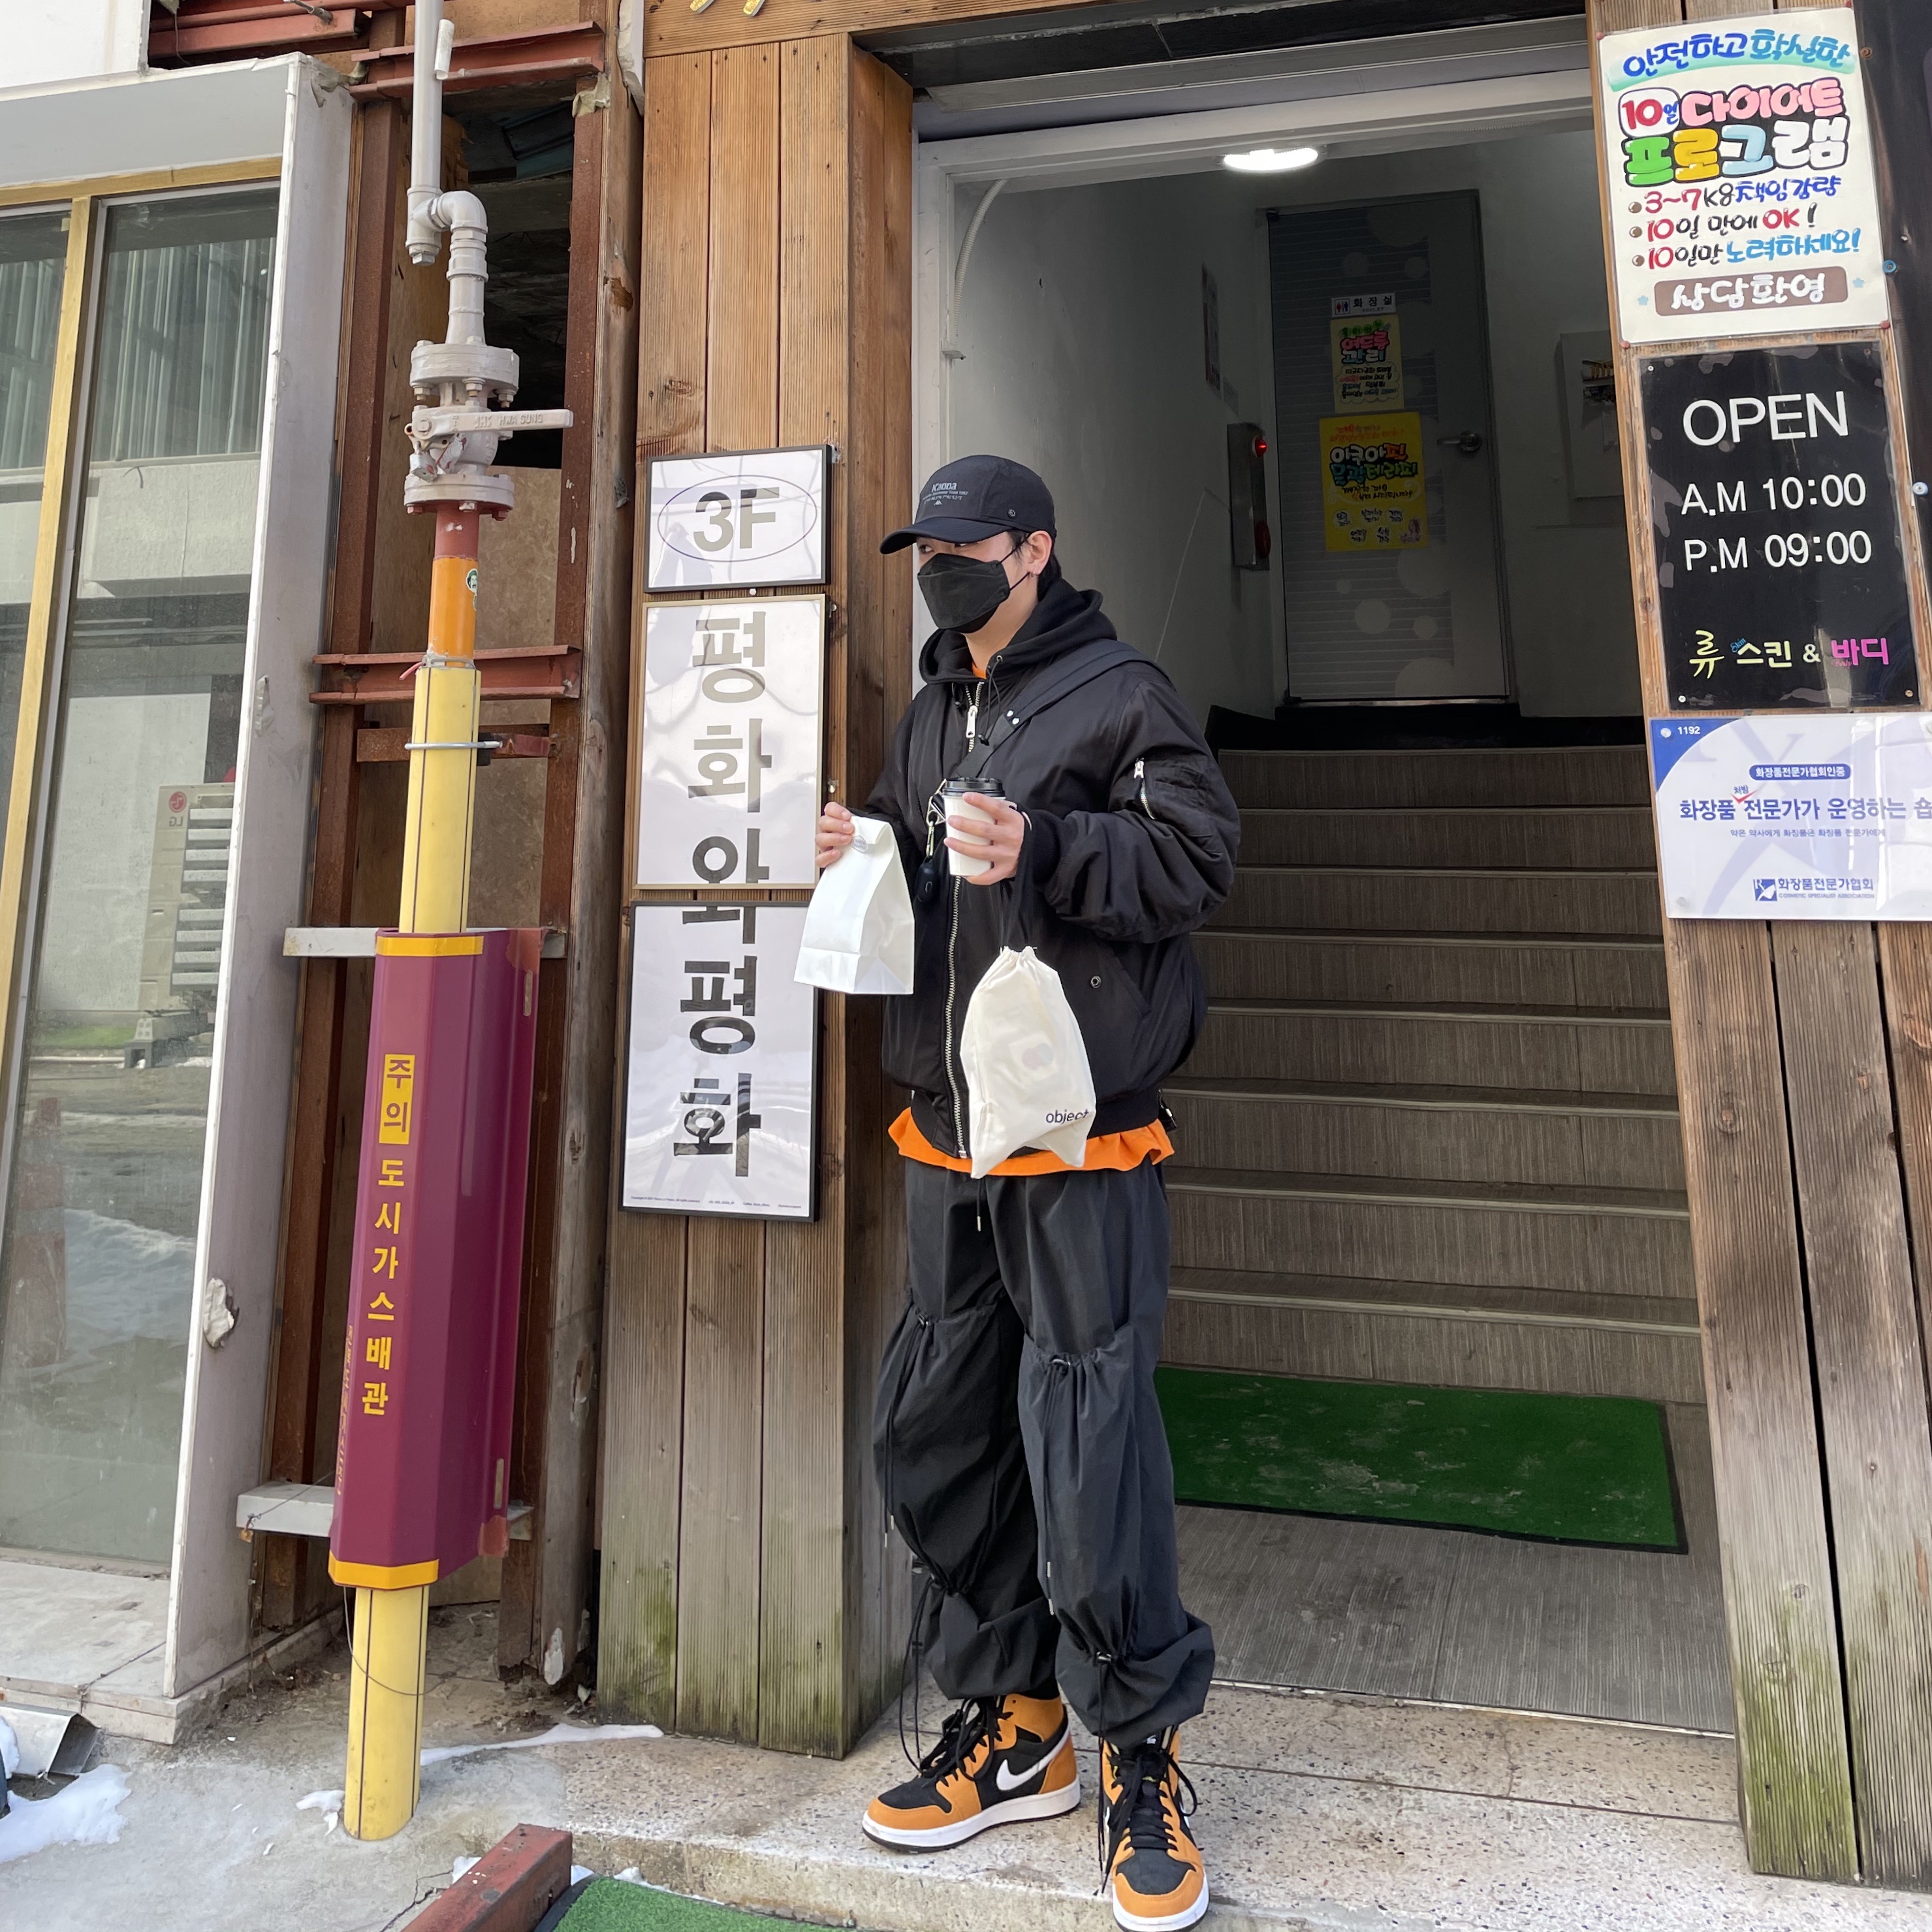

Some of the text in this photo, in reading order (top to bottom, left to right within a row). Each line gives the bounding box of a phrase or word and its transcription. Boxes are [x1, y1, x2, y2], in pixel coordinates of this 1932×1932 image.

[1623, 29, 1850, 76] 안전하고 확실한
[1681, 78, 1843, 126] 다이어트
[1624, 116, 1849, 185] 프로그램
[1647, 215, 1700, 242] 10일
[1708, 215, 1758, 236] 만에
[1726, 228, 1861, 263] 노력하세요!
[1683, 391, 1848, 445] OPEN
[1681, 473, 1866, 515] A.M 10:00
[693, 487, 780, 552] 3F
[1685, 531, 1872, 573] P.M 09:00
[1689, 629, 1890, 678] 류 스킨 & 바디
[1677, 726, 1700, 735] 1192
[1755, 767, 1846, 778] 화장품전문가협회인증
[1680, 799, 1735, 821] 화장품
[1744, 798, 1820, 820] 전문가가
[1828, 797, 1907, 820] 운영하는
[1730, 829, 1747, 837] 약은
[1749, 829, 1781, 837] 약사에게
[1778, 878, 1874, 891] 화장품전문가협회
[383, 1058, 412, 1133] 주의
[1046, 1109, 1089, 1125] object
